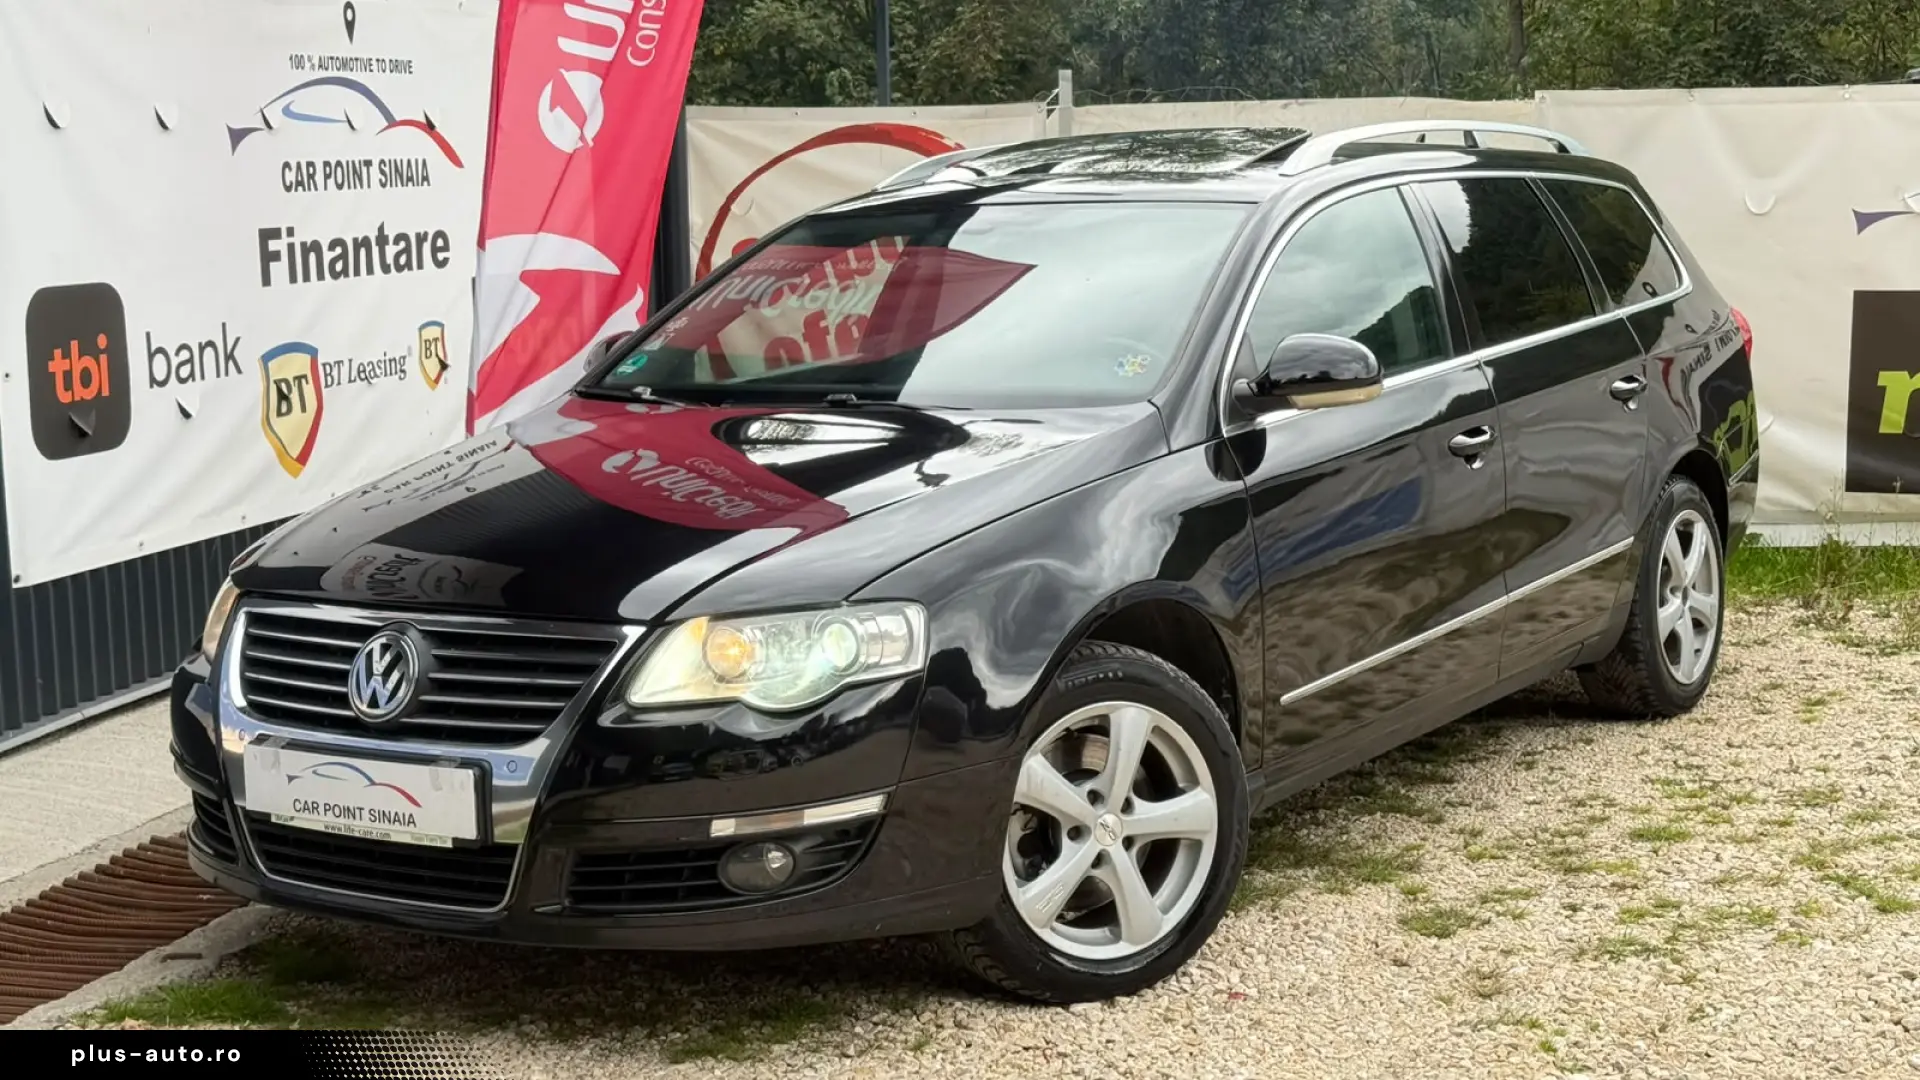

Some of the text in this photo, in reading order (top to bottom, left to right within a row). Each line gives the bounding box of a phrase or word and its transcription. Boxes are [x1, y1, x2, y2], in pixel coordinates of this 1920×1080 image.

[289, 53, 413, 75] 100 % AUTOMOTIVE TO DRIVE
[281, 158, 431, 193] CAR POINT SINAIA
[258, 221, 450, 287] Finantare
[48, 322, 243, 403] tbi bank
[424, 336, 440, 360] BT
[322, 351, 408, 389] BT Leasing
[273, 373, 309, 418] BT
[293, 798, 417, 829] CAR POINT SINAIA
